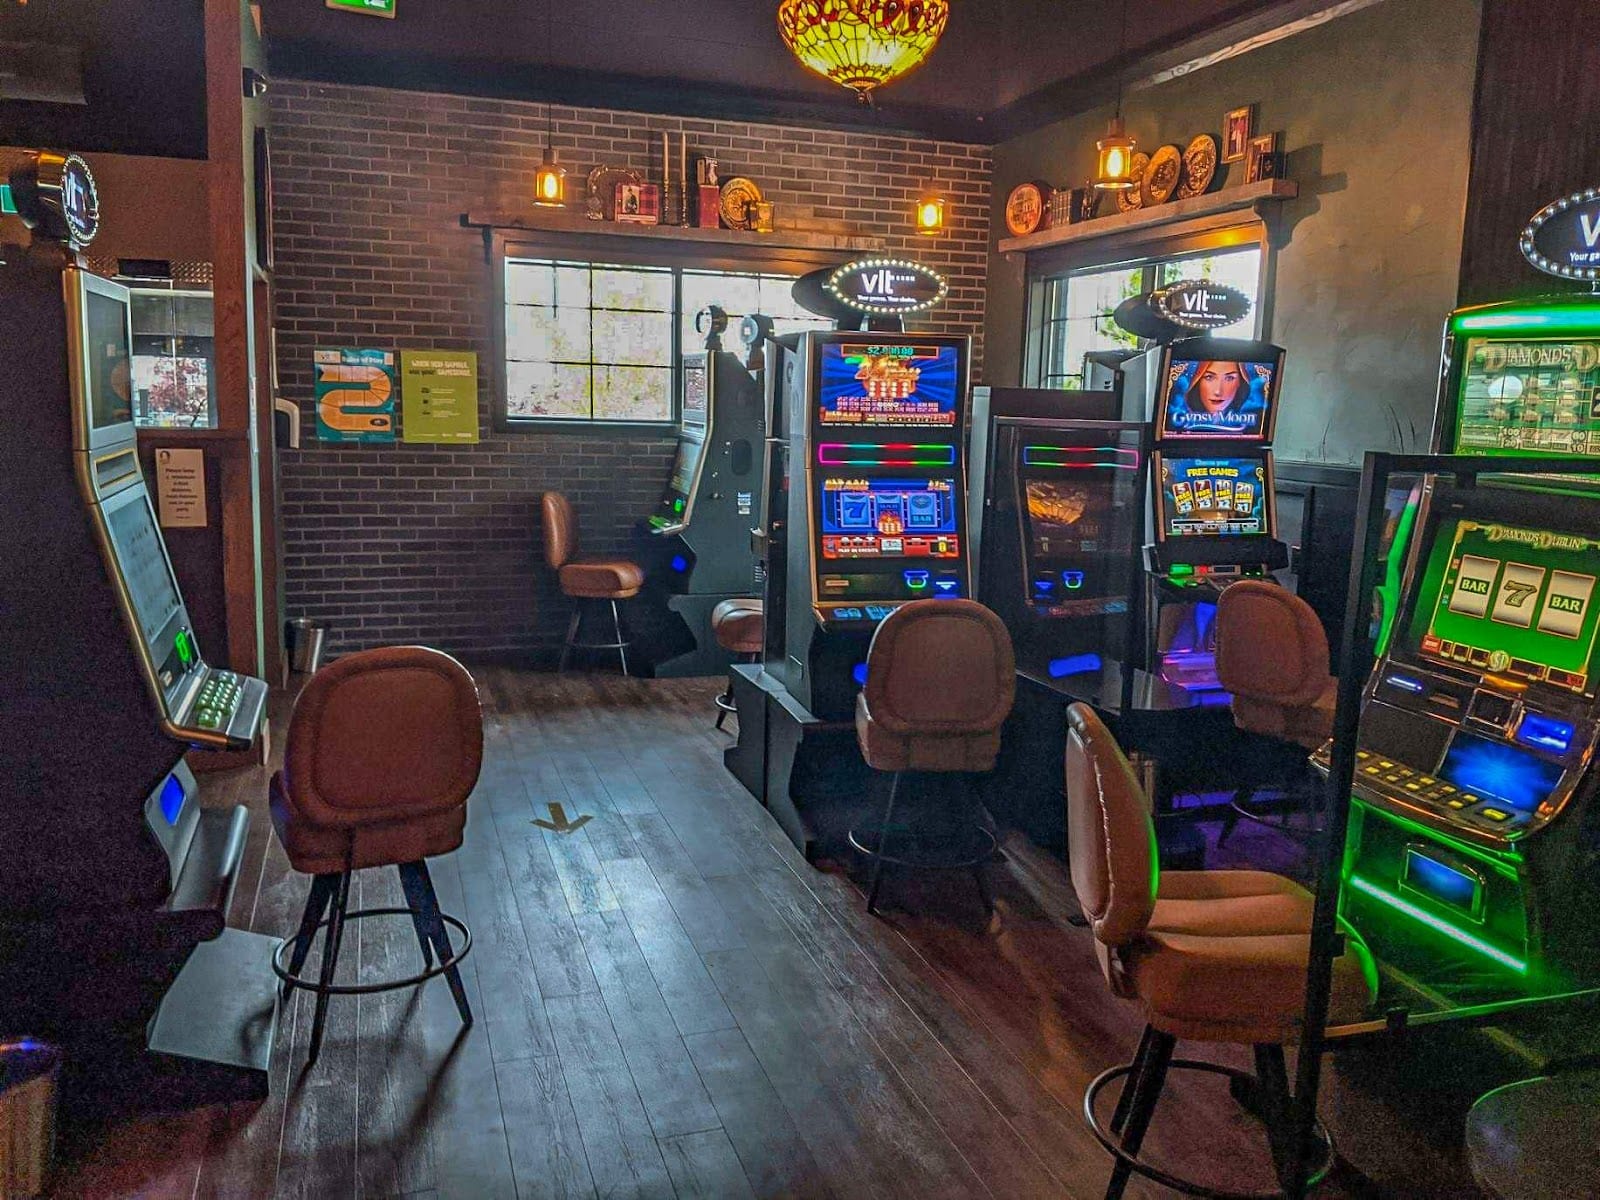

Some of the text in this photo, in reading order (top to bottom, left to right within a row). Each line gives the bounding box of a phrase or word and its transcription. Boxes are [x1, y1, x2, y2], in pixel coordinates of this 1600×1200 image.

[1570, 252, 1588, 262] Your
[861, 269, 895, 295] vlt
[1183, 289, 1210, 312] vlt
[1483, 345, 1572, 372] DIAMONDS
[1172, 411, 1256, 426] Gypsy Moon
[1571, 444, 1585, 453] 10
[1186, 467, 1240, 477] FREE GAMES
[1216, 481, 1231, 490] 10
[845, 501, 867, 519] 7
[912, 515, 932, 523] BAR
[1461, 579, 1487, 593] BAR
[1503, 579, 1538, 608] 7
[1551, 595, 1581, 612] BAR
